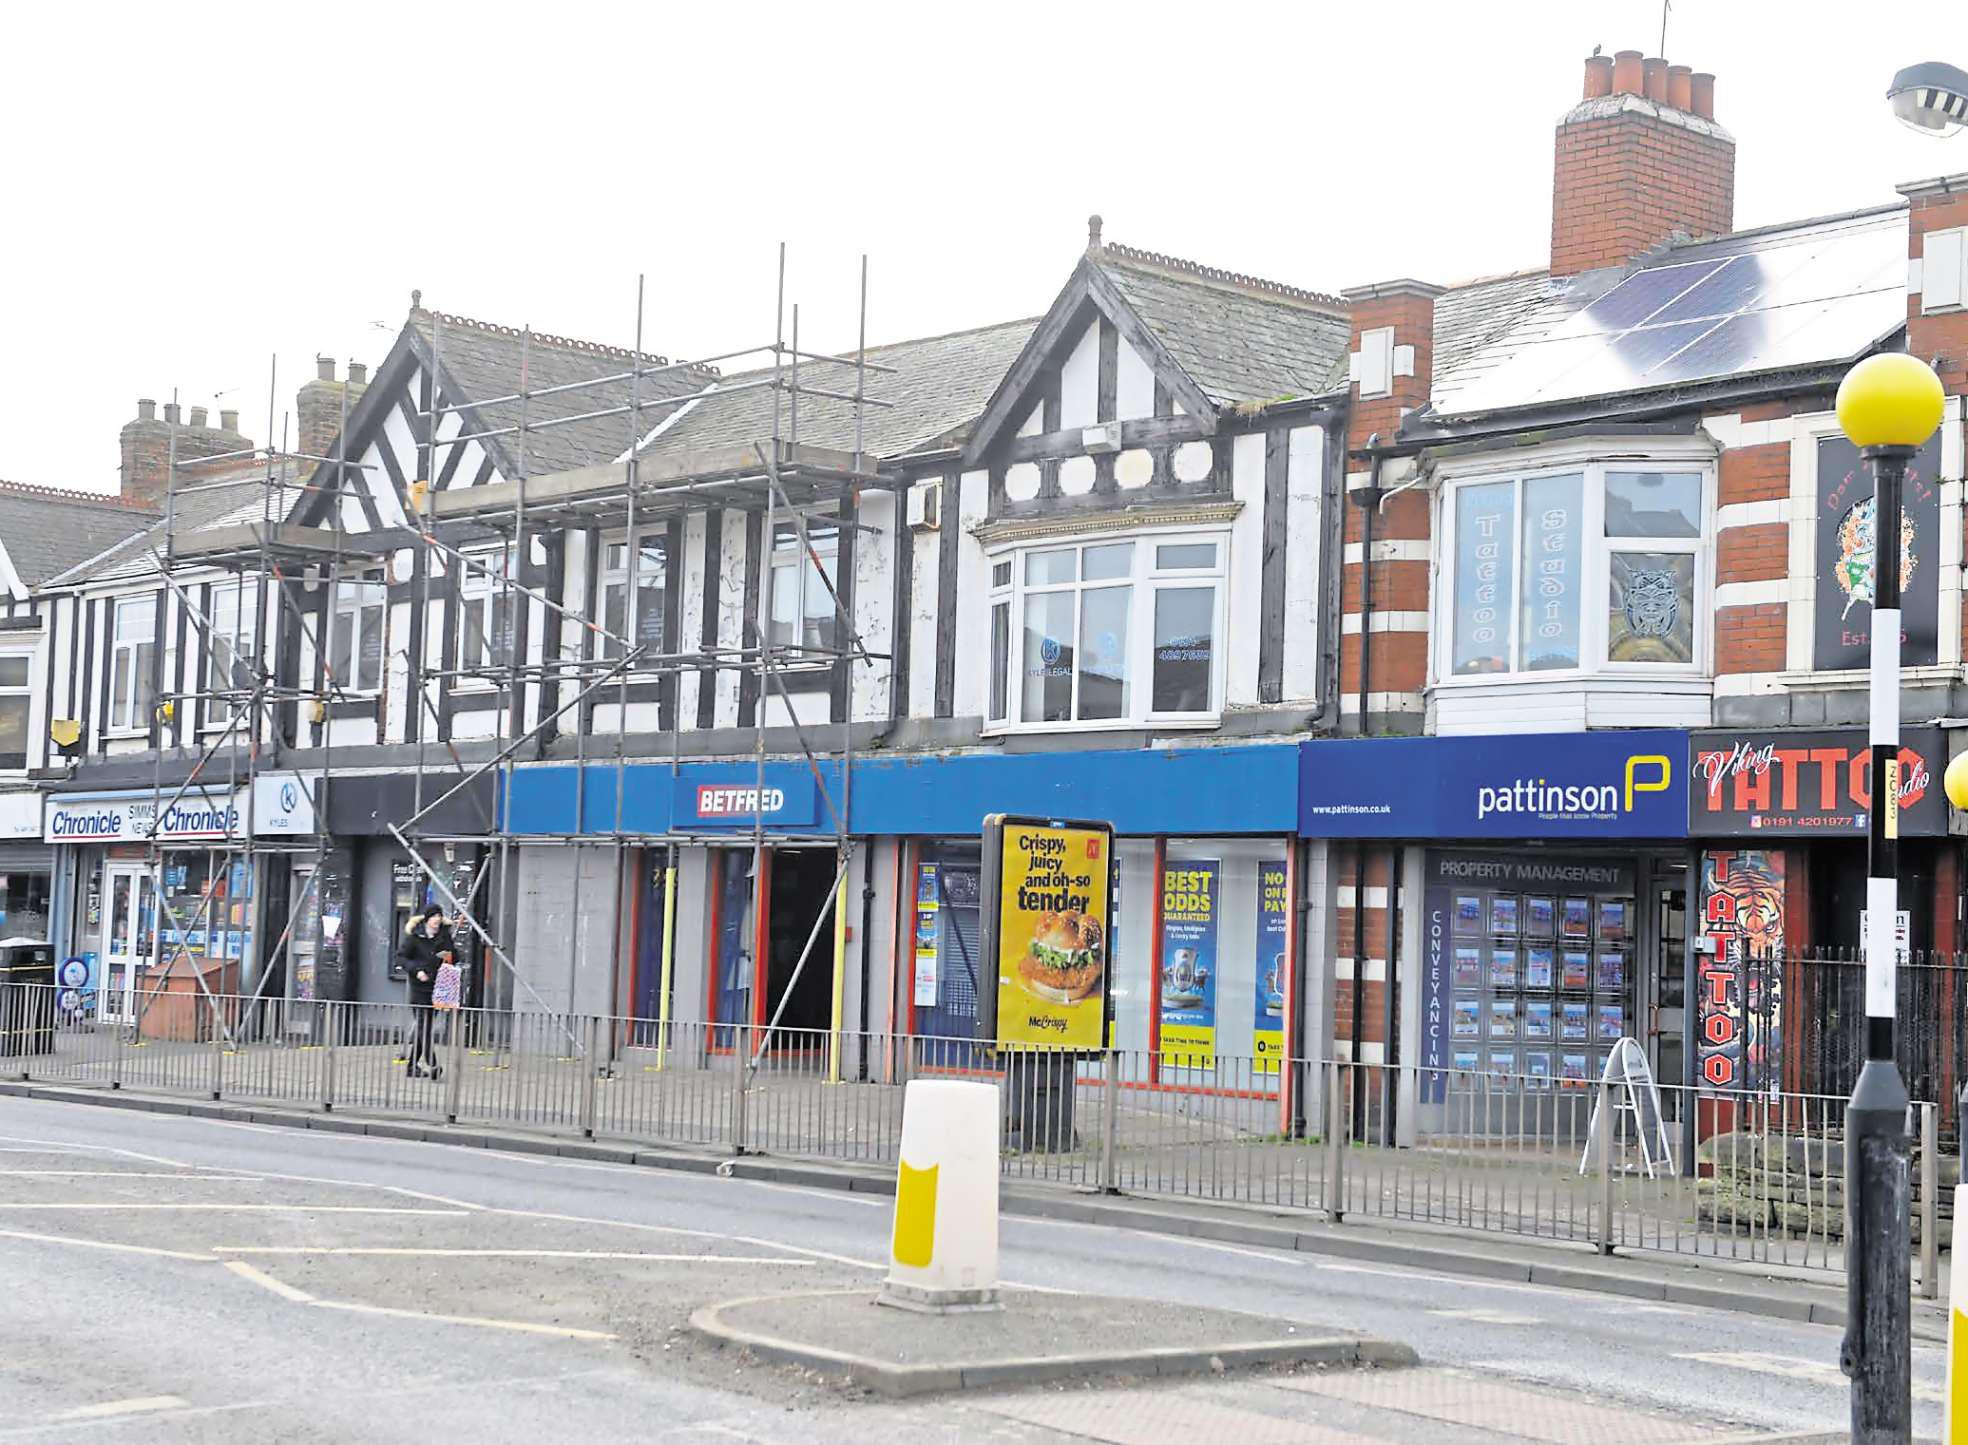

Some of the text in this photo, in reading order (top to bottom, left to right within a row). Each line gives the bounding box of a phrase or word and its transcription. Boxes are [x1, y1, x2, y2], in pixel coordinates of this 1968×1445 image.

[1693, 741, 1781, 798] Viking
[701, 789, 784, 812] BETFRED
[1312, 804, 1391, 816] www.pattinson.co.uk
[1478, 778, 1618, 820] pattinson
[53, 811, 121, 835] Chronicle
[164, 805, 239, 832] Chronicle
[1762, 816, 1853, 828] 0191 4201977
[1019, 834, 1066, 854] Crispy,
[1029, 852, 1063, 873] juicy
[1440, 861, 1620, 883] PROPERTY MANAGEMENT
[1025, 873, 1091, 887] and oh-so
[1165, 871, 1213, 893] BEST
[1264, 872, 1284, 885] NO
[1018, 887, 1090, 914] tender
[1165, 893, 1212, 912] ODDS
[1704, 852, 1737, 1086] TATTOO
